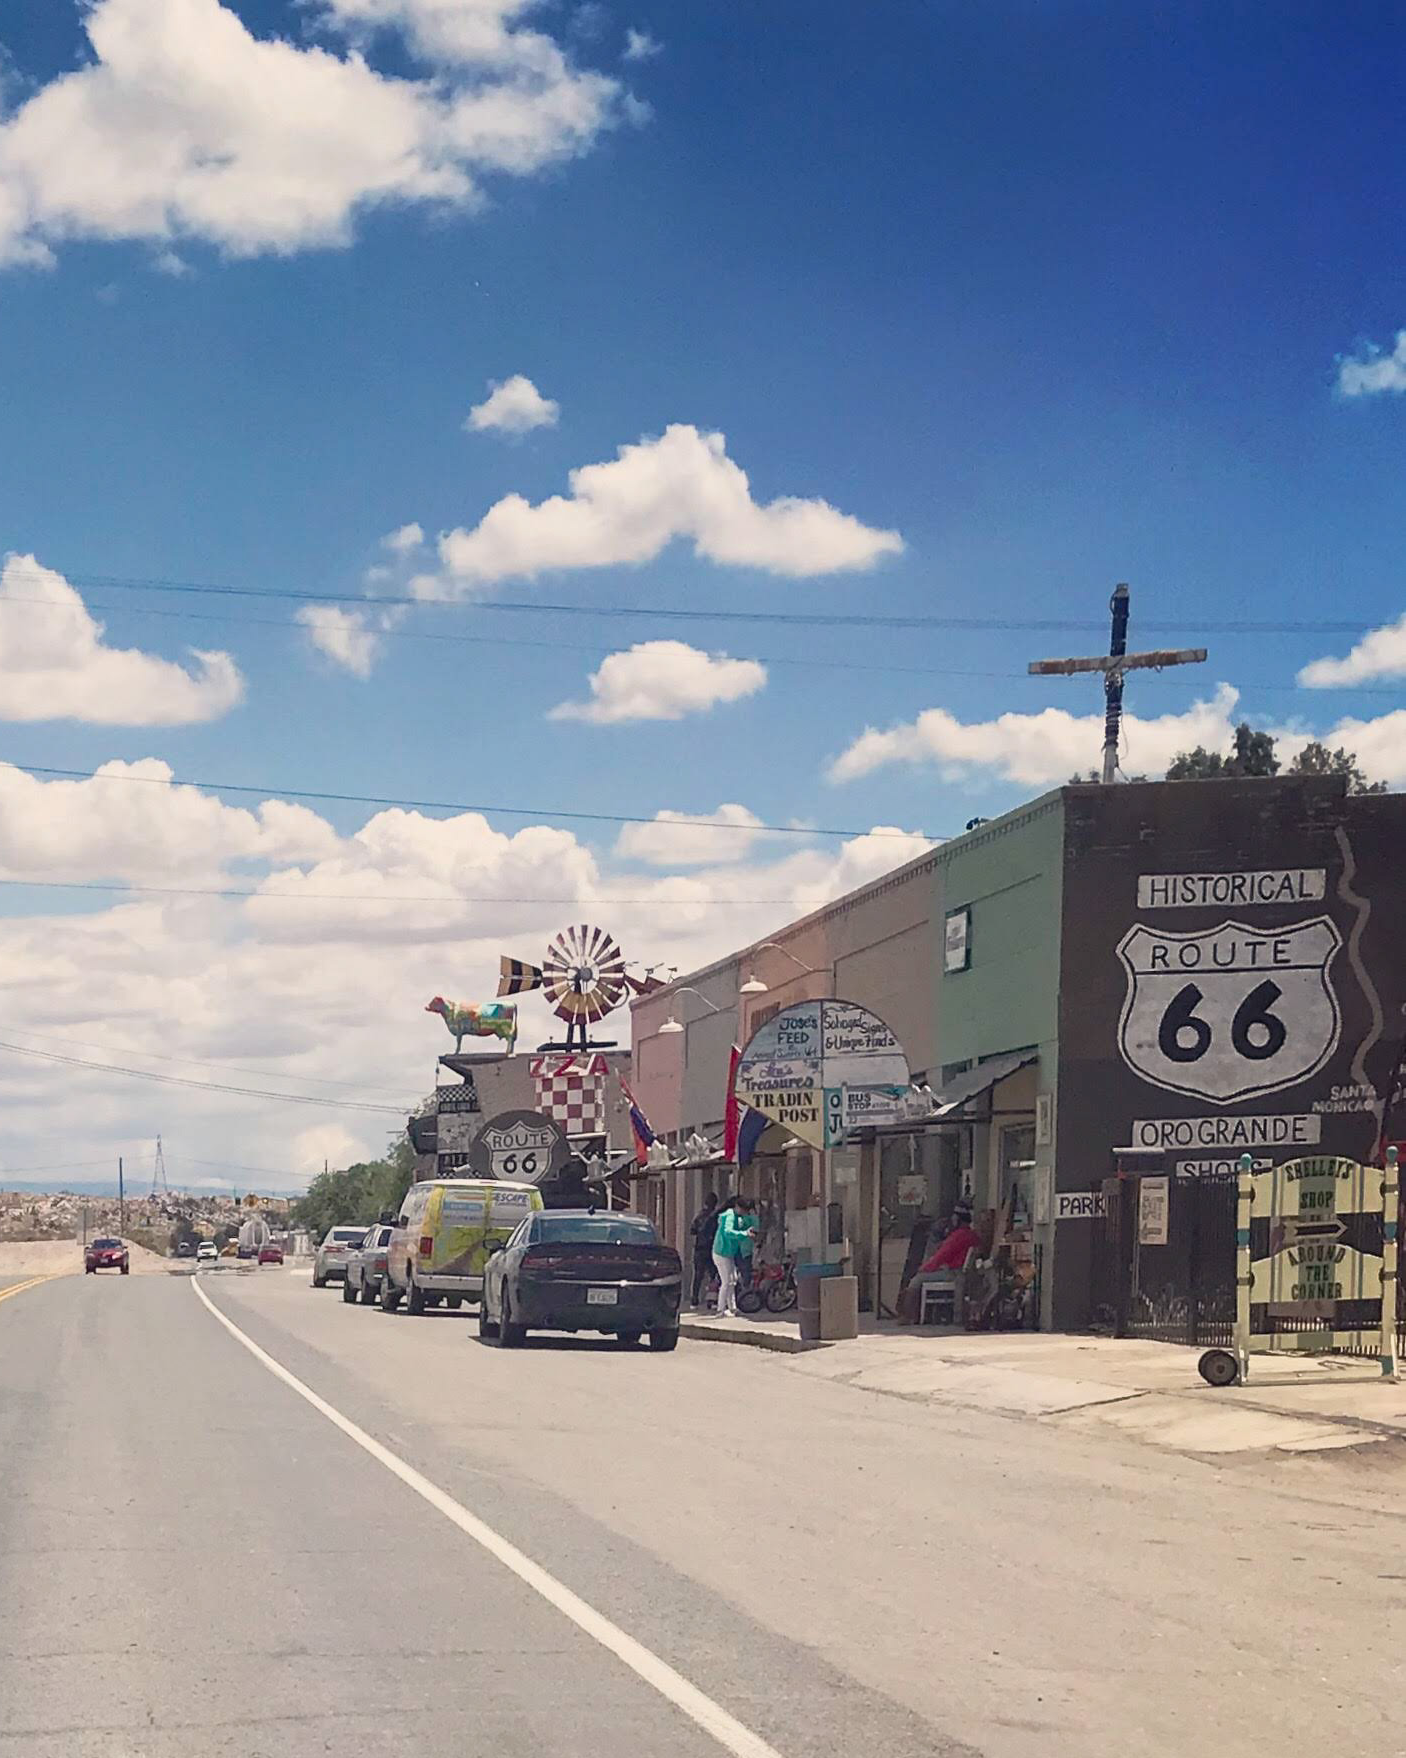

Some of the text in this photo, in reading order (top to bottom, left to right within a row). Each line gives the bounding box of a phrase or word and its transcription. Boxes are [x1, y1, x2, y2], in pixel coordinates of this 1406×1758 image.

[1150, 872, 1314, 906] HISTORICAL
[1151, 939, 1291, 969] ROUTE
[1158, 979, 1287, 1063] 66
[777, 1032, 810, 1044] FEED
[753, 1091, 814, 1108] TRADIN
[1330, 1086, 1376, 1101] SANTA
[779, 1108, 819, 1122] POST
[1311, 1100, 1365, 1113] MONICA
[493, 1132, 550, 1149] ROUTE
[502, 1152, 537, 1174] 66
[495, 1193, 529, 1202] ESCAPE
[1300, 1191, 1334, 1209] SHOP
[1287, 1245, 1347, 1266] AROUND
[1305, 1265, 1329, 1282] THE
[1291, 1282, 1343, 1300] CORNER
